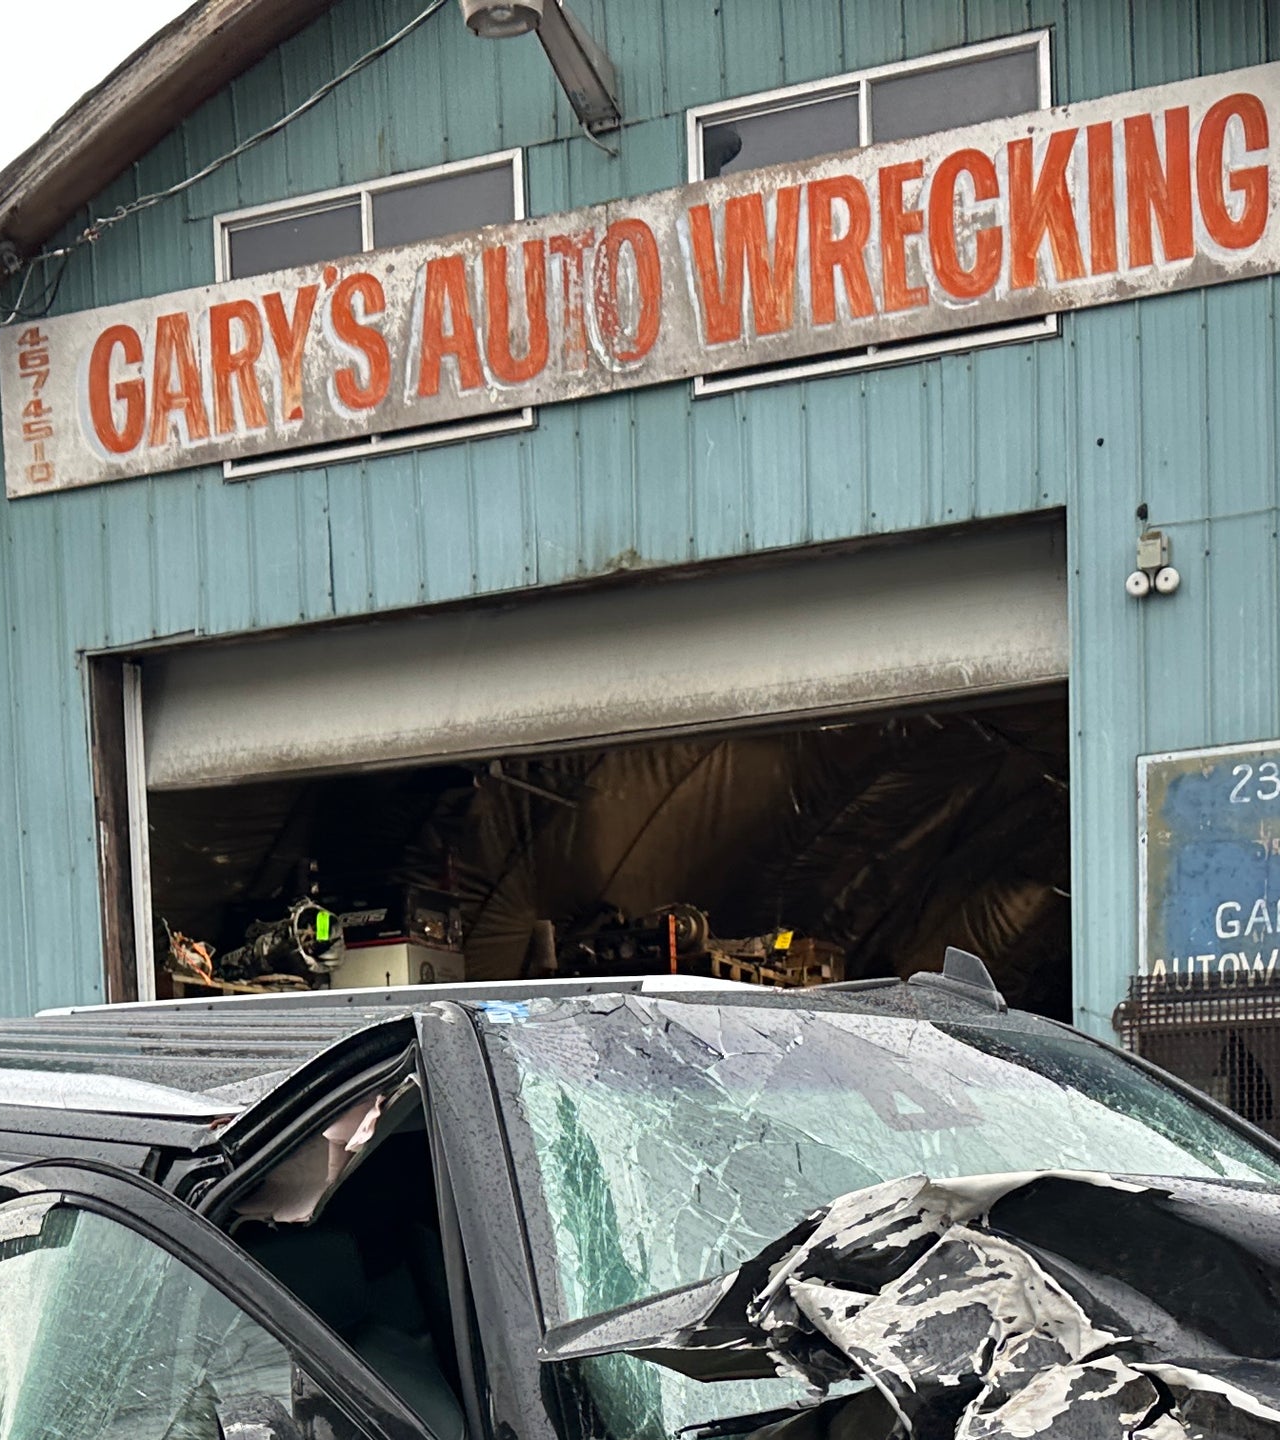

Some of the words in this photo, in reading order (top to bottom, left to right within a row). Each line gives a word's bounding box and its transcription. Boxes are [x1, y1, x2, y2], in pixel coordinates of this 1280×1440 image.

[86, 266, 391, 454] GARY'S
[417, 217, 663, 398] AUTO
[687, 92, 1271, 346] WRECKING
